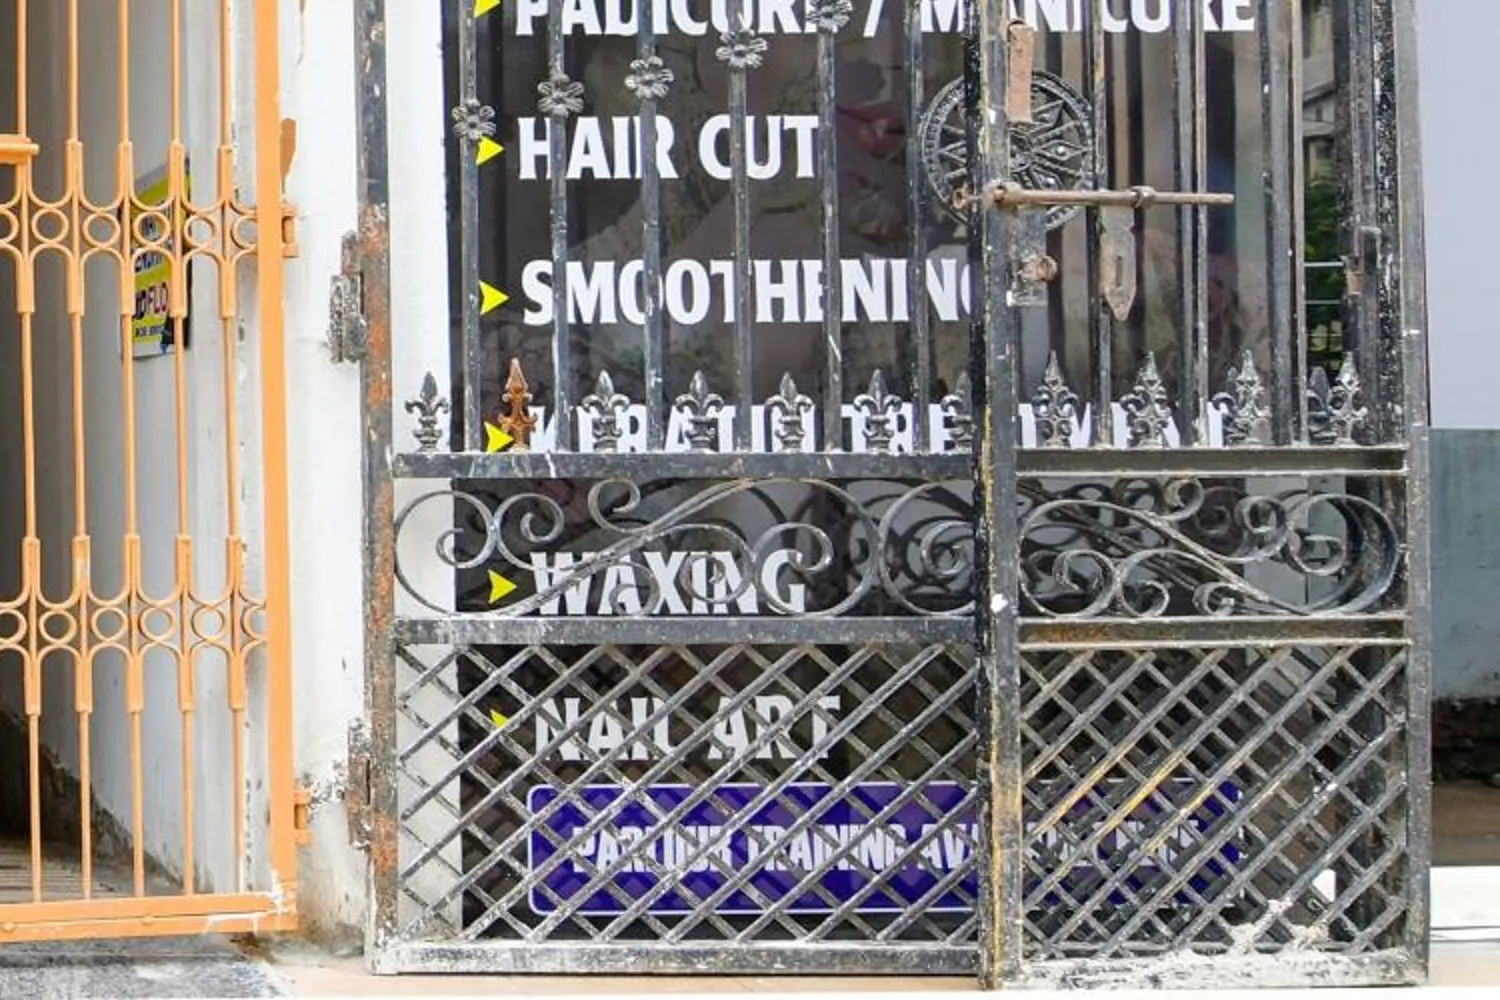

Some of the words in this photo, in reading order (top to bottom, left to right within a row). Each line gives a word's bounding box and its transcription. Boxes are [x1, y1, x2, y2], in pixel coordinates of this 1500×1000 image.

[518, 116, 679, 180] HAIR
[700, 115, 824, 180] CUT
[521, 258, 974, 327] SMOOTHENIN
[530, 549, 806, 615] WAXING
[707, 694, 841, 761] ART
